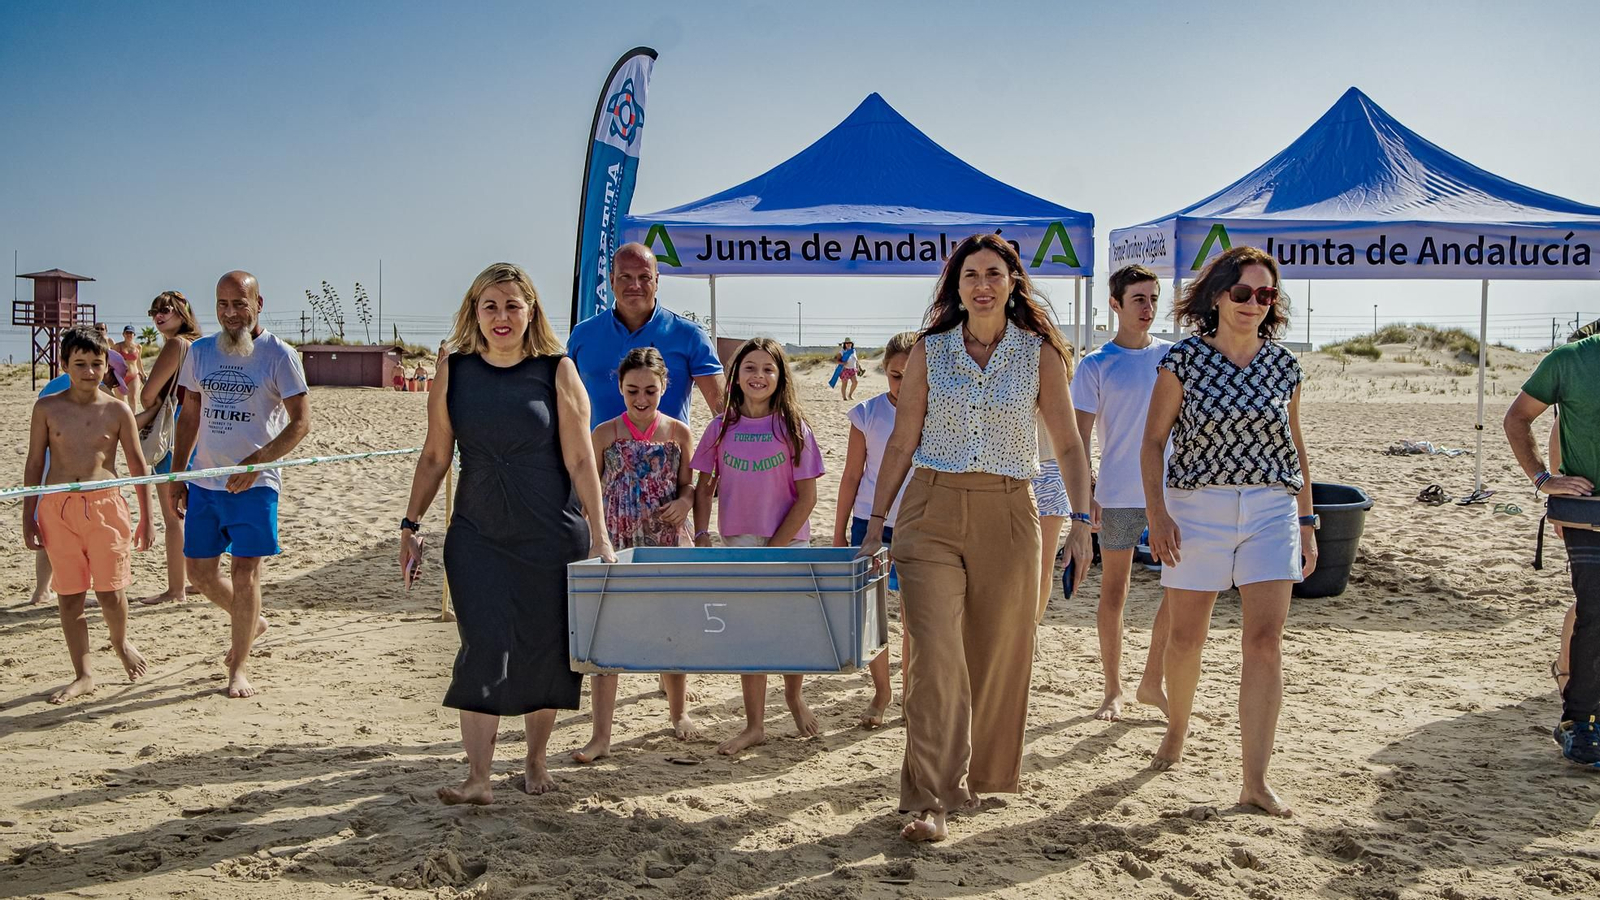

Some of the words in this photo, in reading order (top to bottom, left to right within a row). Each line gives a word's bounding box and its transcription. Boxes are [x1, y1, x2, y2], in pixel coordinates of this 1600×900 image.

[696, 233, 791, 262] Junta
[801, 232, 842, 262] de
[850, 228, 1020, 262] Andal
[1365, 235, 1408, 266] de
[1415, 231, 1591, 266] Andalucía
[199, 379, 253, 393] HORIZON
[204, 407, 251, 422] FUTURE
[734, 432, 773, 442] FOREVER
[723, 450, 749, 472] KIND
[752, 451, 786, 472] MOOD
[704, 603, 727, 633] 5
